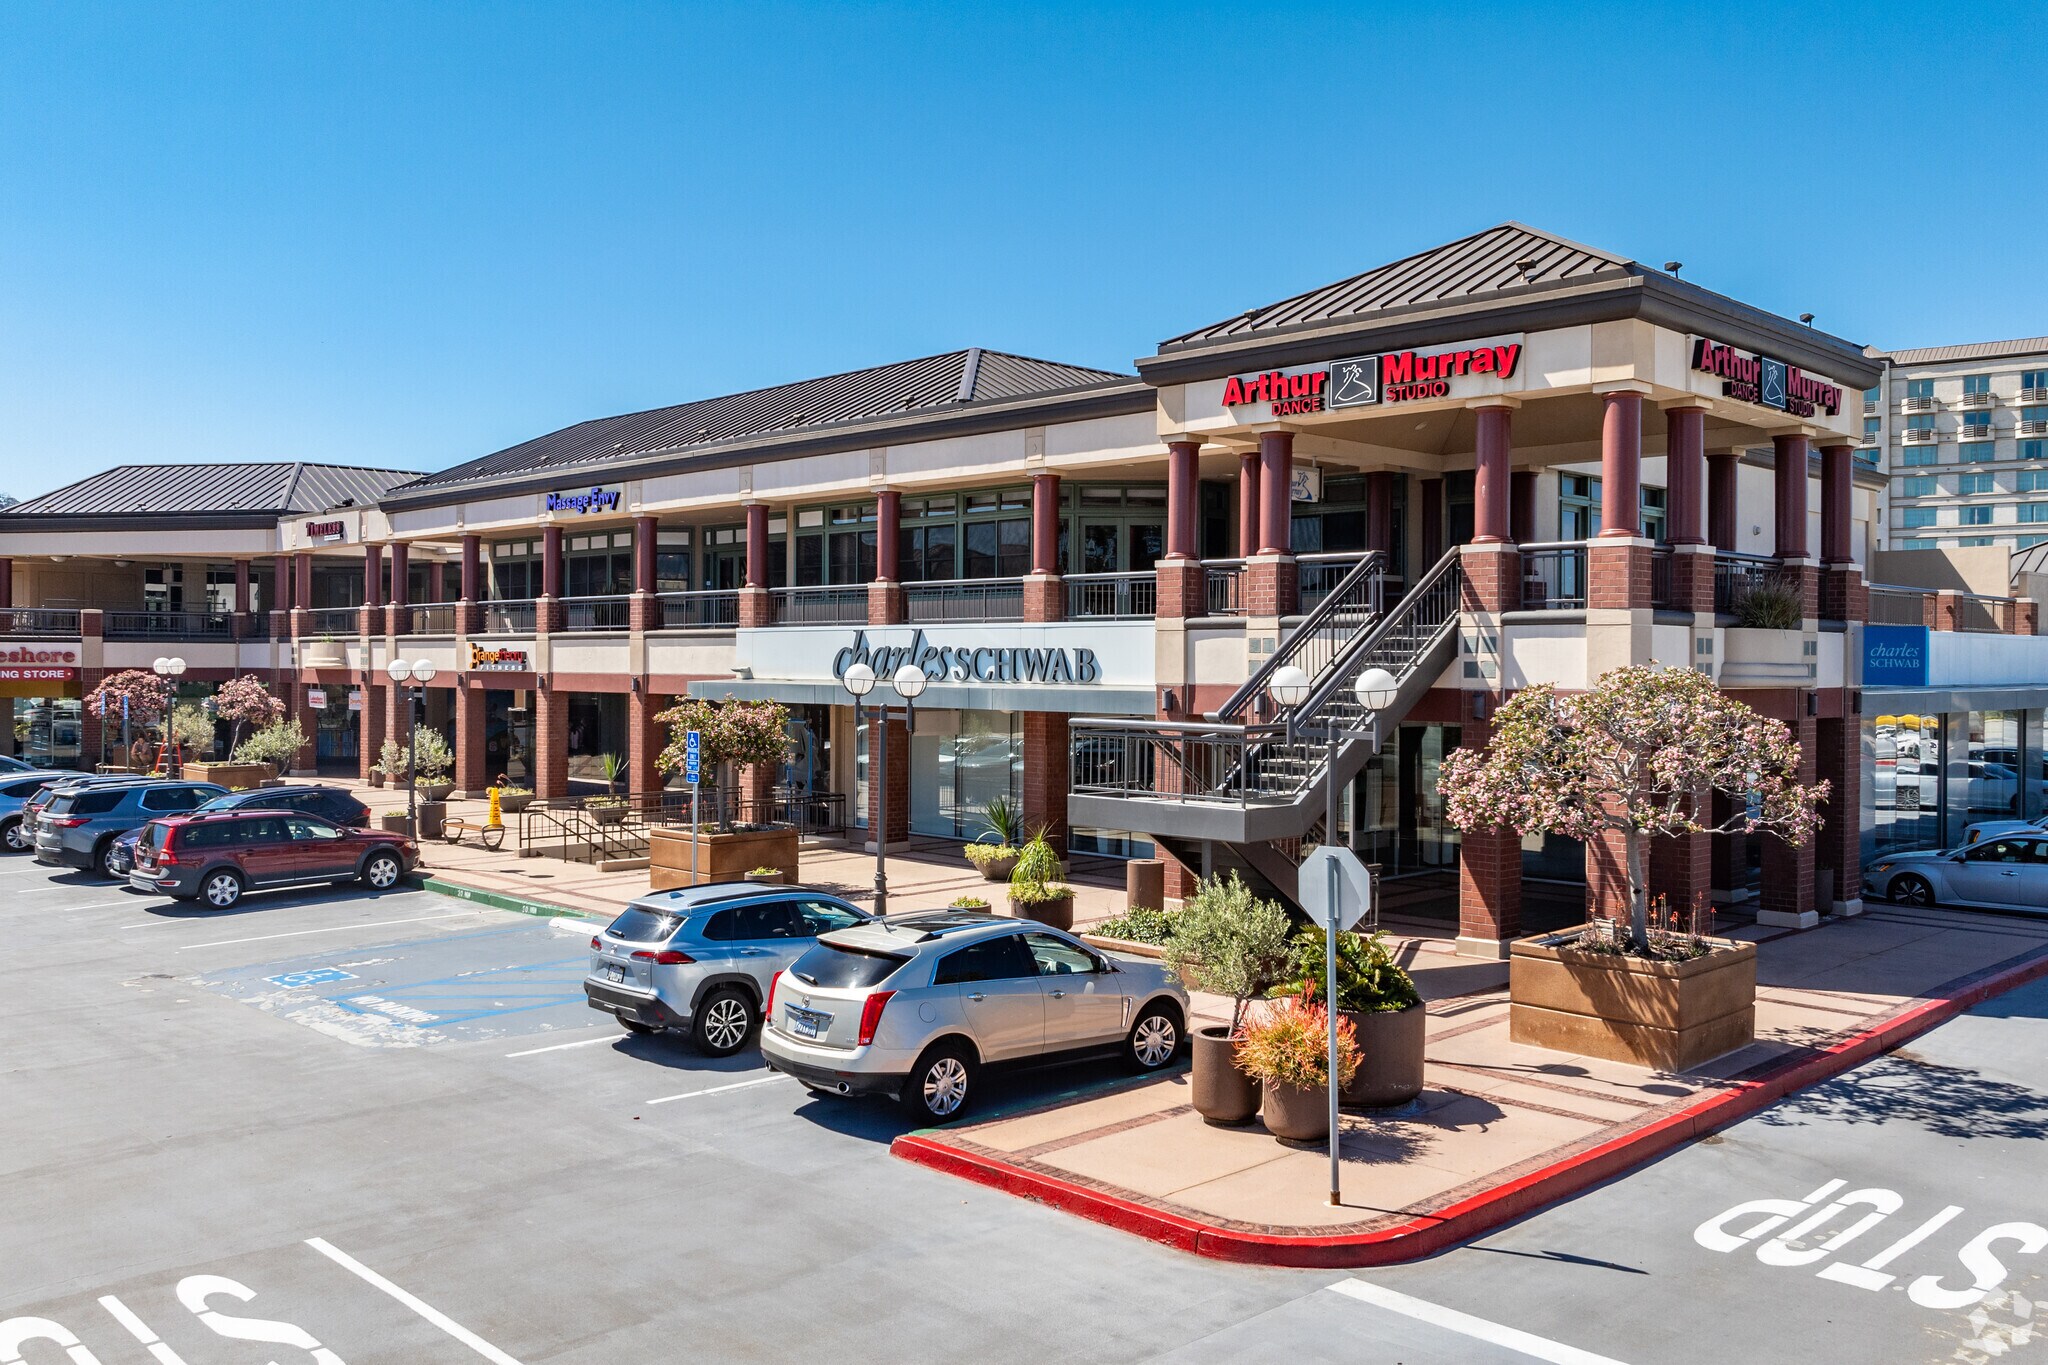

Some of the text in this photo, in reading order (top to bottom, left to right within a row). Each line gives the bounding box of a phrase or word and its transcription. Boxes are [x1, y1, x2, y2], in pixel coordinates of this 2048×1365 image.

[1222, 344, 1521, 407] Arthur Murray
[1697, 339, 1843, 416] Arthur Murray
[1271, 381, 1448, 416] DANCE STUDIO
[1730, 381, 1816, 417] DANCE STUDIO
[547, 487, 619, 514] Massage Envy
[0, 647, 76, 663] eshore
[832, 629, 1097, 682] charles SCHWAB
[1870, 643, 1920, 657] charles
[1870, 659, 1920, 668] SCHWAB
[23, 670, 65, 678] STORE
[1693, 1178, 2048, 1310] STOP
